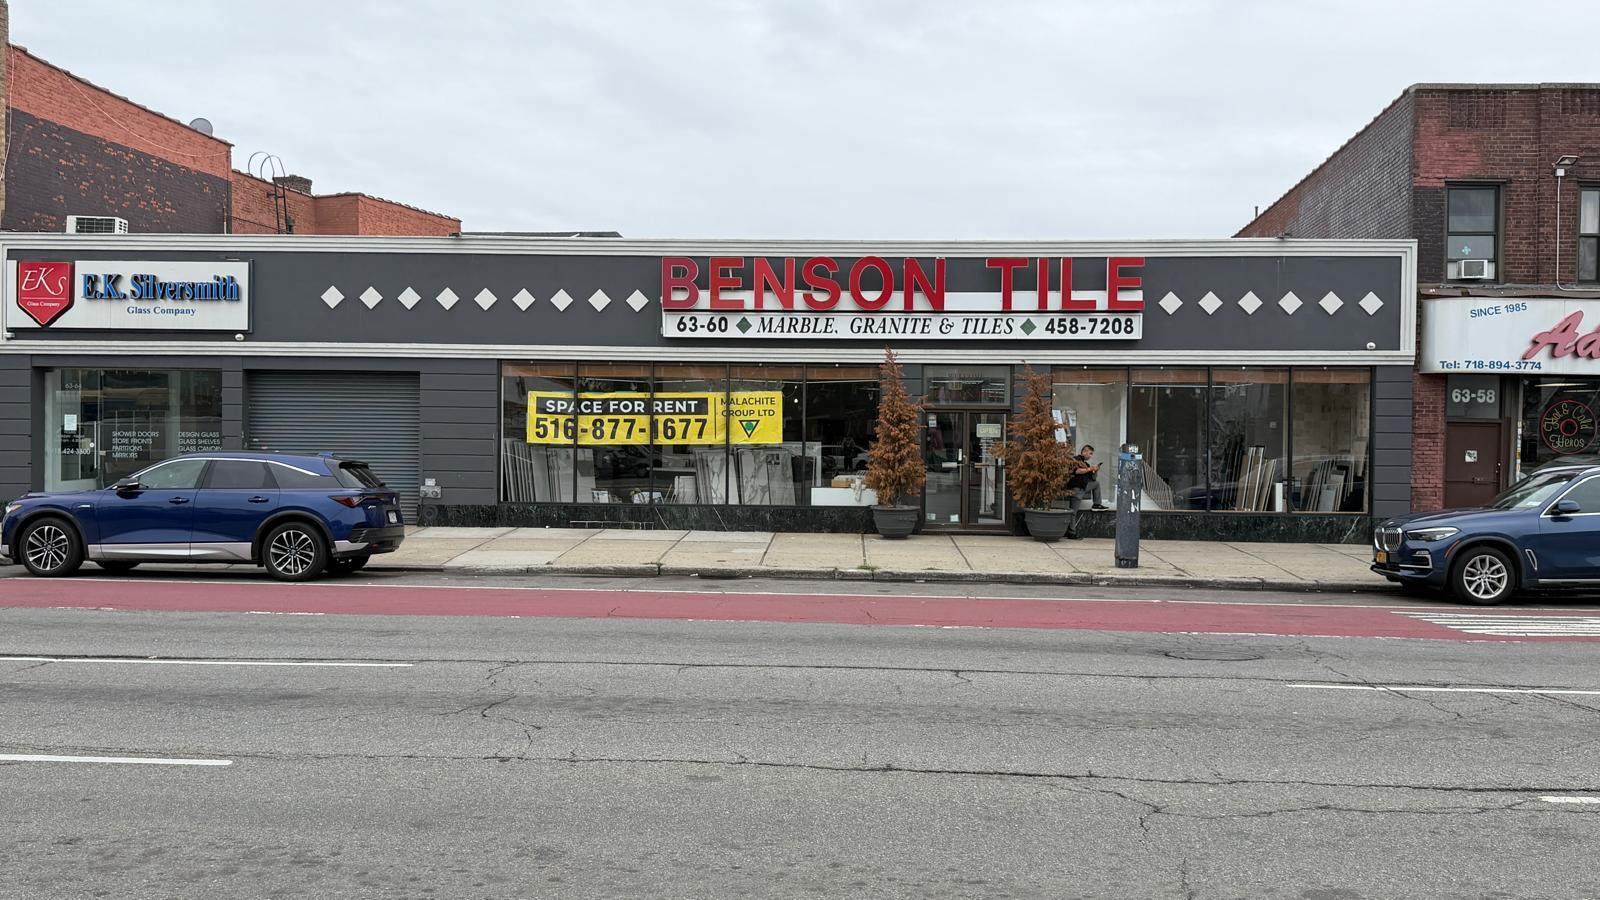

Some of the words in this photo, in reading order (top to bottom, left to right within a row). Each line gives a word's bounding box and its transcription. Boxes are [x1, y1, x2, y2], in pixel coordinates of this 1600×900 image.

[81, 273, 127, 300] E.K.
[130, 273, 241, 301] Silversmith
[662, 256, 945, 311] BENSON
[985, 256, 1146, 312] TILE
[126, 306, 151, 315] Glass
[153, 306, 196, 316] Company
[1470, 305, 1502, 319] SINCE
[1503, 302, 1528, 314] 1985
[676, 316, 729, 333] 63-60
[849, 316, 932, 335] GRANITE
[938, 317, 955, 335] &
[961, 317, 1015, 335] TILES
[1044, 317, 1135, 335] 458-7208
[1440, 361, 1460, 369] Tel:
[1464, 361, 1542, 371] 718-894-3774
[720, 396, 777, 406] MALACHITE
[1451, 388, 1496, 404] 63-58
[546, 399, 603, 413] SPACE
[609, 399, 646, 414] FOR
[652, 399, 699, 413] RENT
[721, 409, 755, 418] GROUP
[758, 409, 776, 418] LTD
[1561, 402, 1570, 415] &
[1571, 405, 1594, 430] Cold
[535, 417, 708, 441] 516-877-1677
